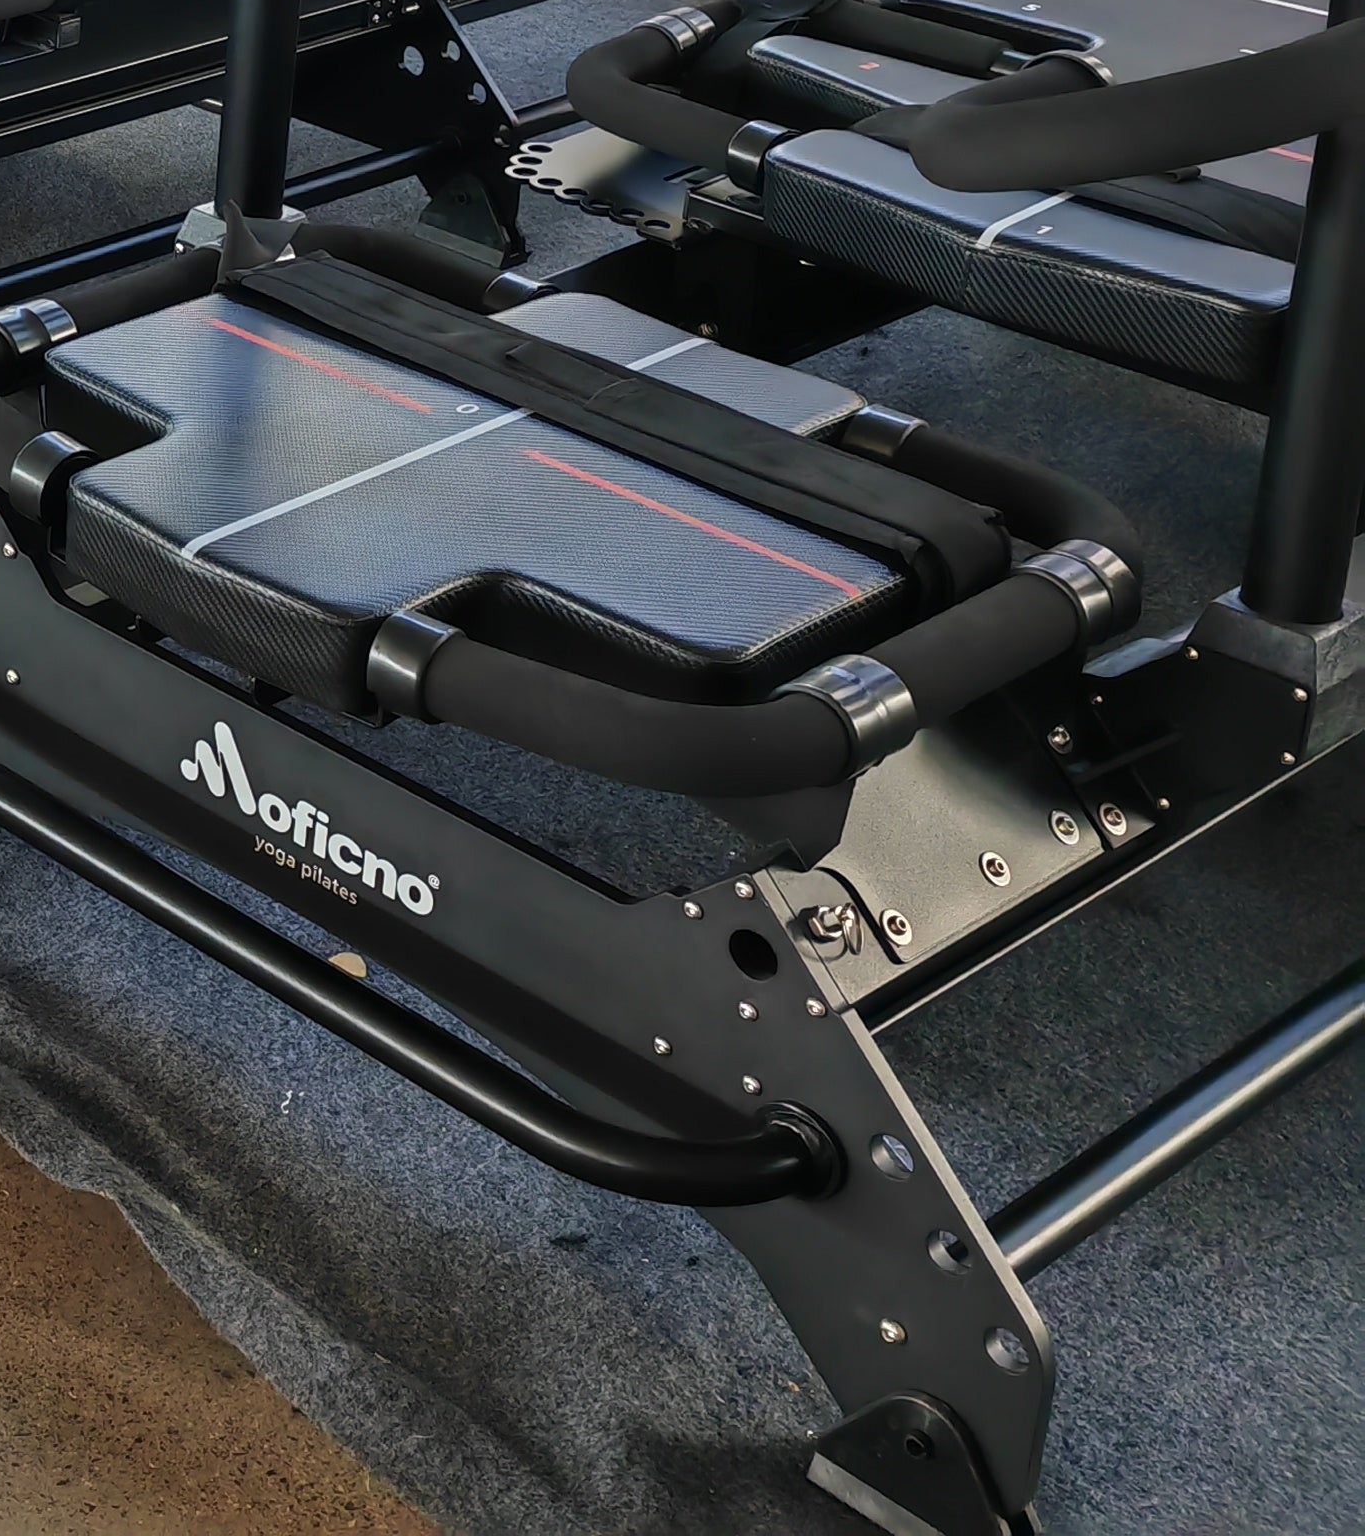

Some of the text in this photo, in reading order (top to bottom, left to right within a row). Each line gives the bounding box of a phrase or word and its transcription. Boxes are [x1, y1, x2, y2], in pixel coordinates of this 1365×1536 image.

[1021, 3, 1042, 12] 5
[254, 834, 359, 906] yoga pilates
